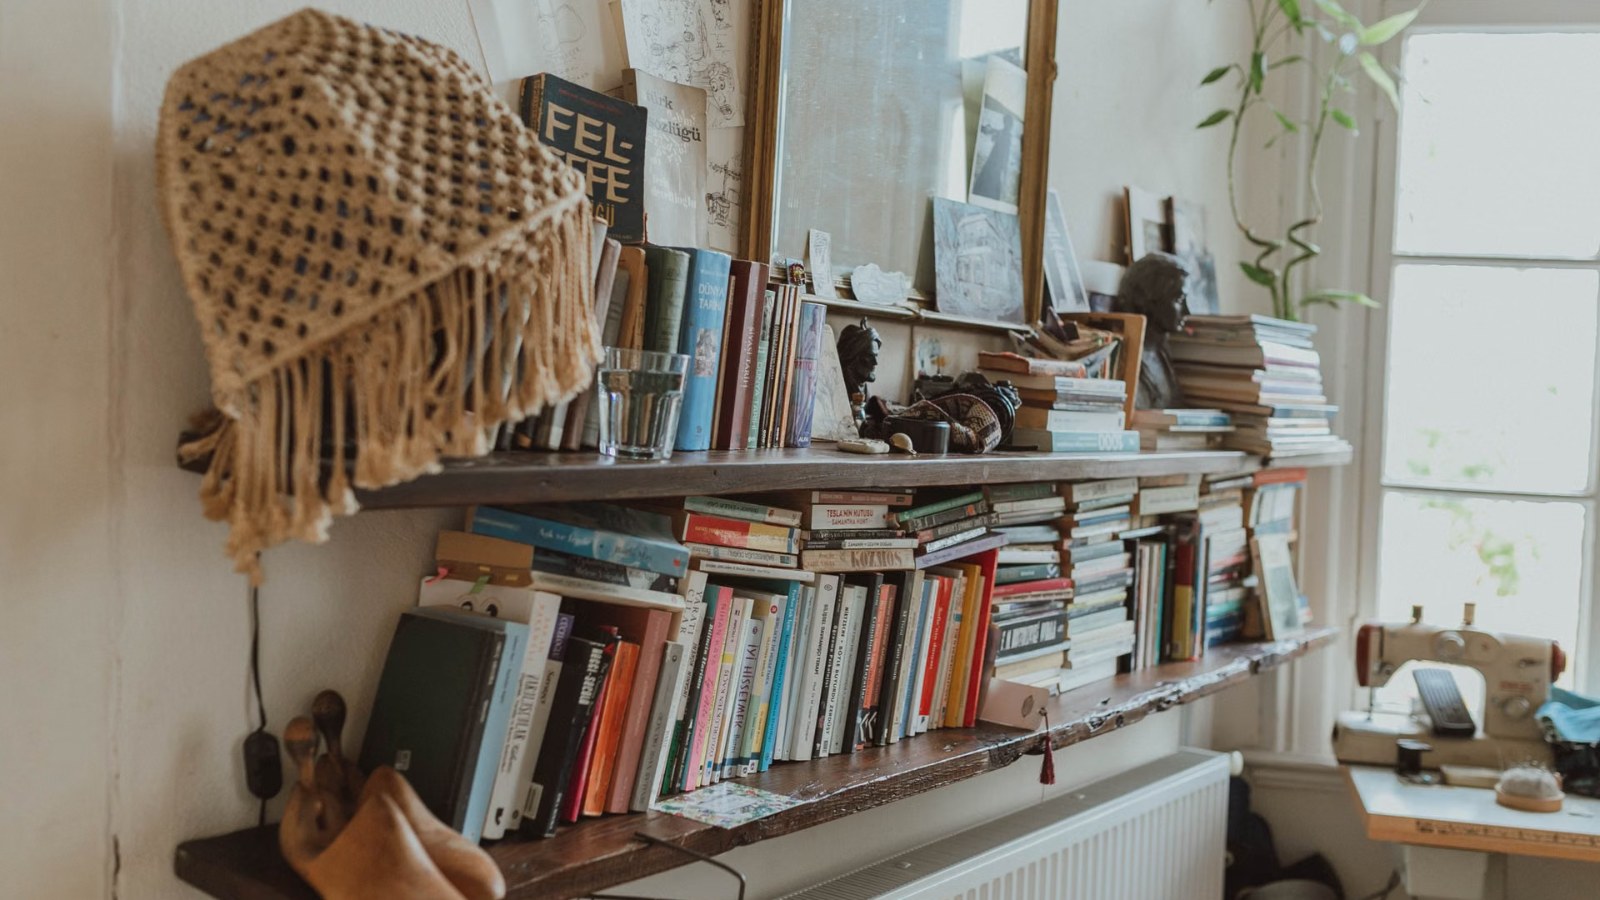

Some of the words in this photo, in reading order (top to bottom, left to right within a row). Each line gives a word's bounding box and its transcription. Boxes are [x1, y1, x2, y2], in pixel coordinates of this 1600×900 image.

[545, 101, 633, 164] FEL-
[851, 550, 902, 568] KOZMOS
[840, 606, 848, 637] NIETZSCHE
[745, 643, 758, 661] İYİ
[835, 645, 843, 667] BÖYLE
[732, 665, 753, 728] HİSSETMEK
[829, 669, 839, 702] BUYURDU
[824, 704, 833, 734] ZERDÜŞT
